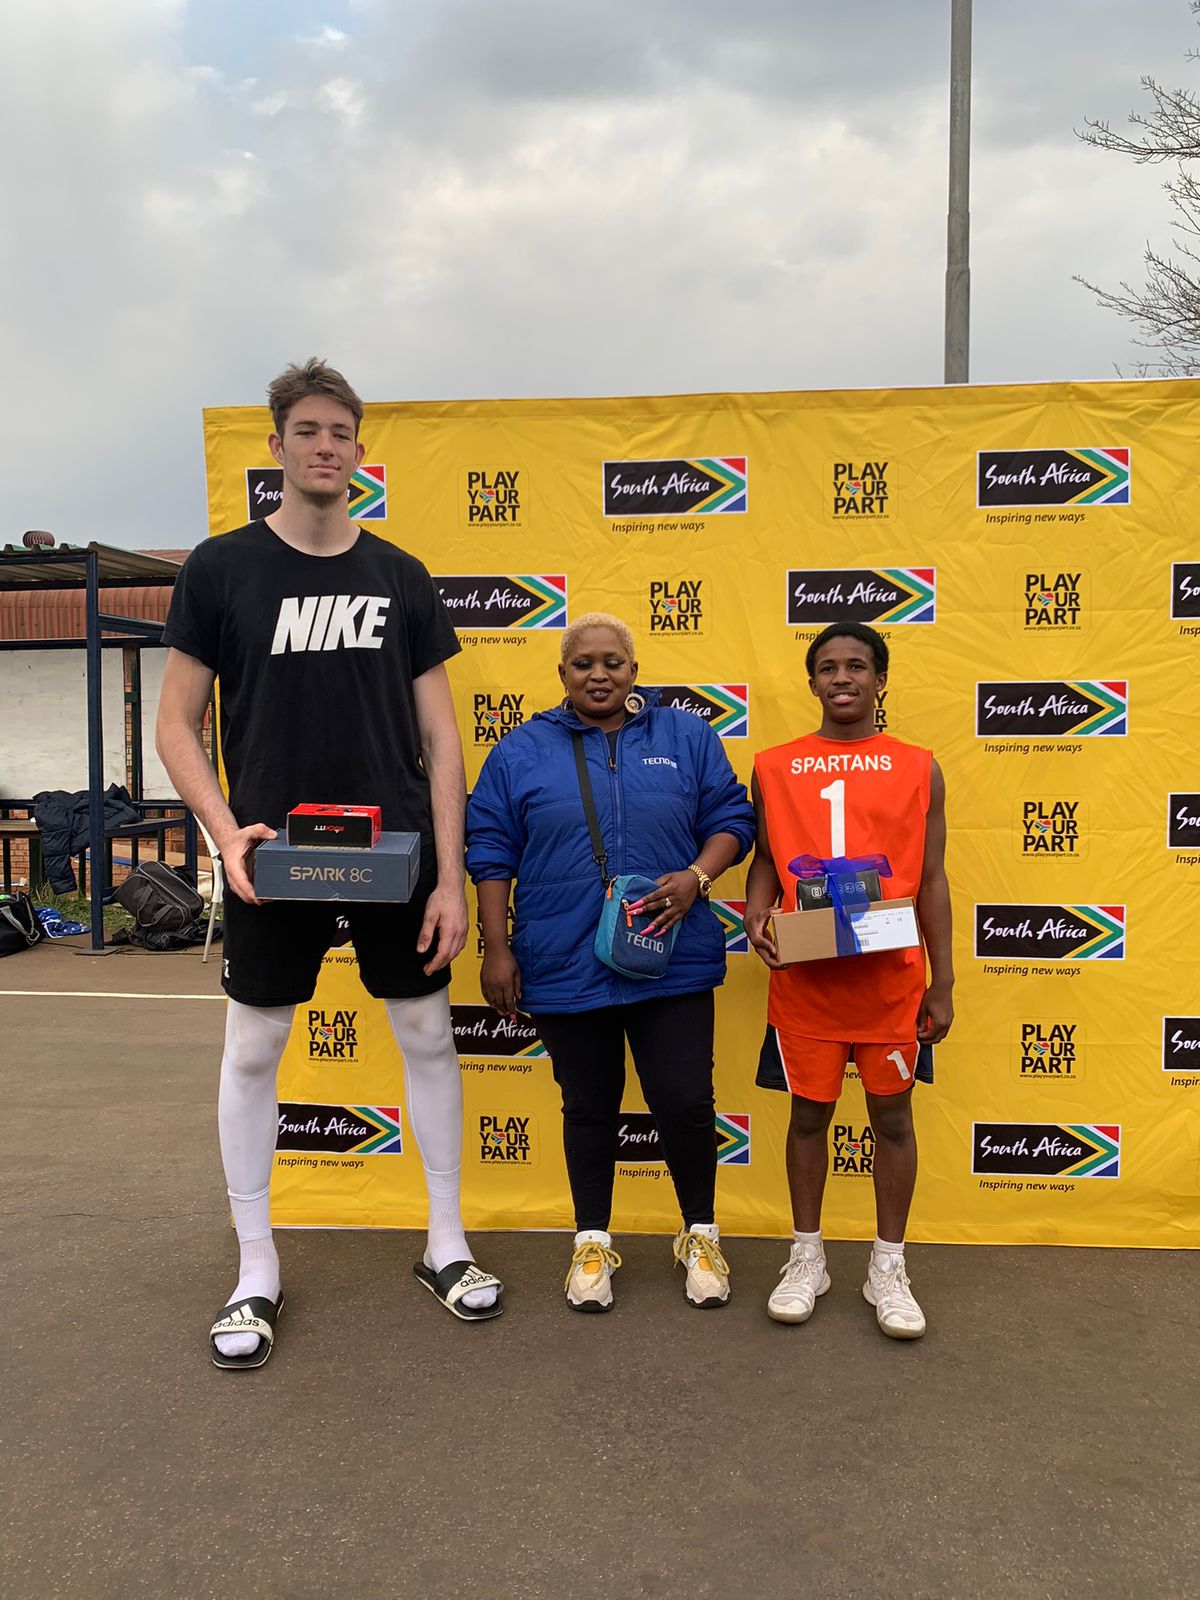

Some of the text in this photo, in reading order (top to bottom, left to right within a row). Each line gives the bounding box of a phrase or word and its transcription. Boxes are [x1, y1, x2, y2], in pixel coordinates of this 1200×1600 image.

[468, 471, 520, 489] PLAY
[834, 462, 889, 481] PLAY
[985, 462, 1091, 489] South Africa
[254, 481, 284, 505] Sou
[610, 472, 710, 499] South Africa
[469, 505, 521, 522] PART
[834, 496, 889, 514] PART
[612, 522, 705, 534] Inspiring new ways
[986, 513, 1085, 525] Inspiring new ways
[650, 581, 703, 599] PLAY
[1026, 573, 1082, 592] PLAY
[484, 588, 531, 610] Africa
[794, 582, 897, 607] South Africa
[270, 595, 391, 655] NIKE
[651, 614, 703, 631] PART
[1025, 607, 1081, 625] PART
[480, 636, 501, 644] new
[502, 636, 527, 647] ways
[474, 694, 525, 711] PLAY
[984, 694, 1089, 719] South Africa
[984, 743, 1083, 755] Inspiring new ways
[641, 757, 671, 765] TECNO
[791, 754, 893, 775] SPARTANS
[820, 779, 846, 859] 1
[1023, 801, 1080, 820] PLAY
[1023, 835, 1079, 852] PART
[289, 866, 373, 883] SPARK 8C
[982, 917, 1087, 940] South Africa
[626, 931, 665, 954] TECNO
[983, 964, 1081, 978] Inspiring new ways
[308, 1010, 358, 1028] PLAY
[450, 1017, 537, 1038] outh Africa
[1022, 1023, 1077, 1042] PLAY
[309, 1041, 358, 1058] PART
[487, 1063, 507, 1072] new
[508, 1064, 533, 1075] ways
[886, 1050, 911, 1080] 1
[1021, 1056, 1076, 1073] PART
[279, 1114, 367, 1136] South Africa
[480, 1116, 530, 1133] PLAY
[834, 1125, 876, 1143] PLA
[481, 1145, 531, 1161] PART
[980, 1135, 1082, 1158] South Africa
[278, 1157, 365, 1170] Inspiring new ways
[833, 1157, 873, 1173] PAR
[619, 1168, 661, 1179] Inspiring
[979, 1180, 1076, 1193] Inspiring new ways
[213, 1319, 260, 1329] adidas
